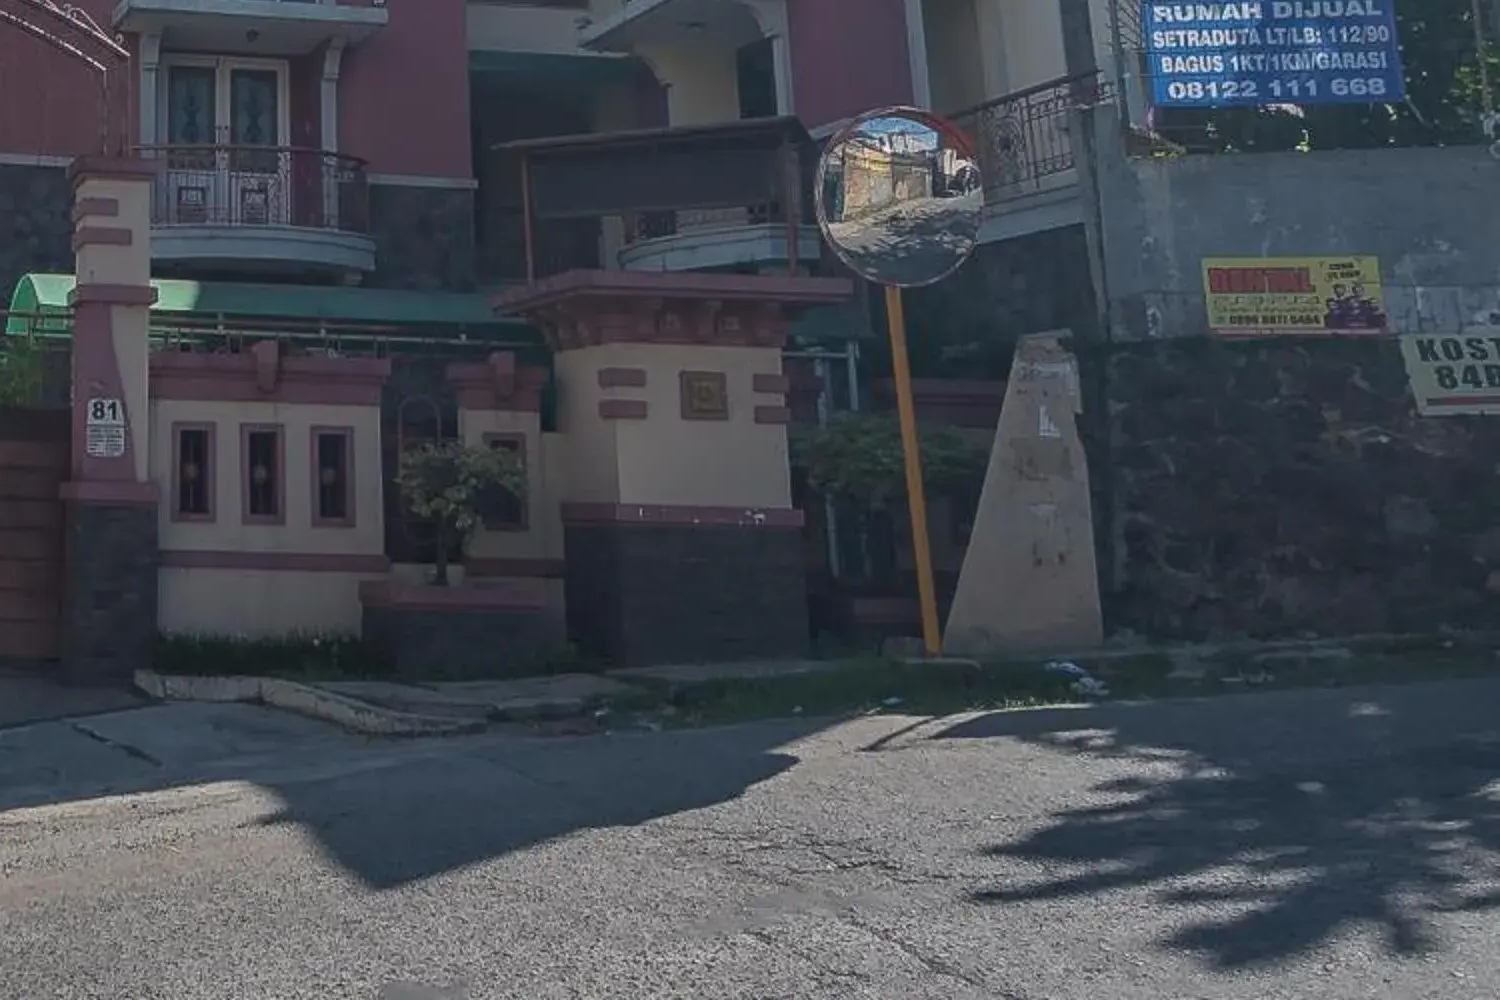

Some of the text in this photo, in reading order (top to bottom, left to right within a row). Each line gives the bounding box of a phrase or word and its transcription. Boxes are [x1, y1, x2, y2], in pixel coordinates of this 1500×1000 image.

[1153, 0, 1382, 22] RUMAH DIJUAL
[1153, 28, 1260, 48] SETRADUTA
[1328, 24, 1389, 44] 112/90
[1161, 55, 1224, 73] BAGUS
[1168, 77, 1386, 99] 08122 111 668
[92, 400, 117, 421] 81
